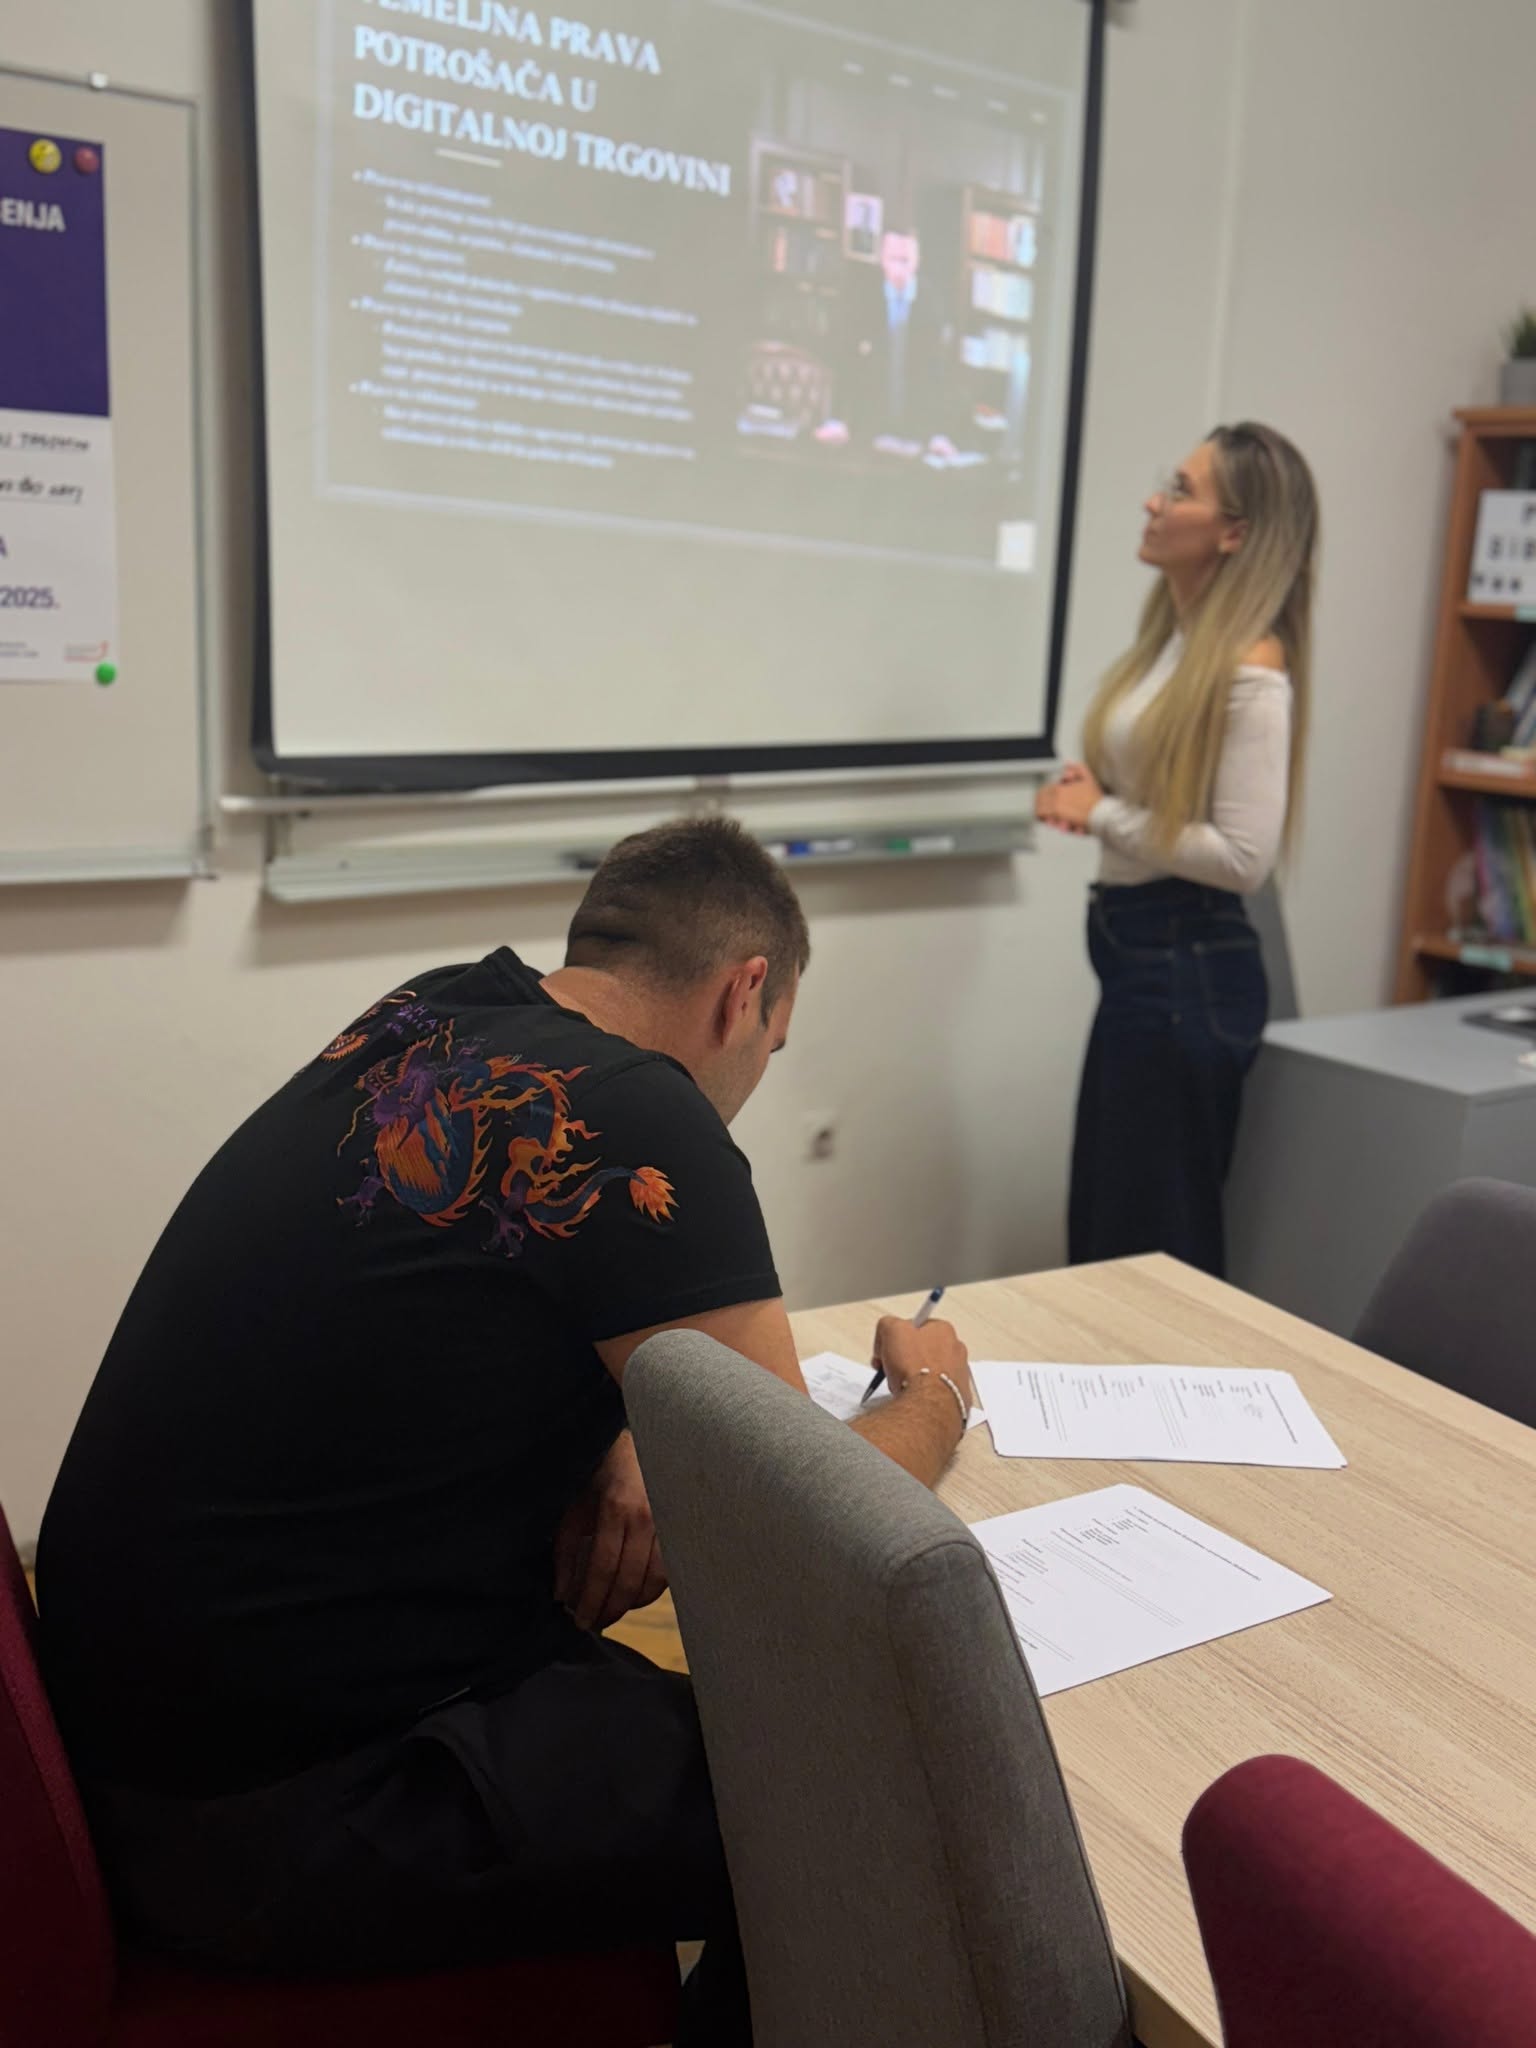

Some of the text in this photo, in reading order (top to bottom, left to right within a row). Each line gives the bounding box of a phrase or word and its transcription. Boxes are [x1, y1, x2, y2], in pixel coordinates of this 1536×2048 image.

[353, 25, 598, 112] POTROŠAČA U
[550, 17, 661, 75] PRAVA
[353, 82, 568, 160] DIGITALNOJ
[573, 132, 732, 196] TRGOVINI
[1, 197, 66, 233] ENJA
